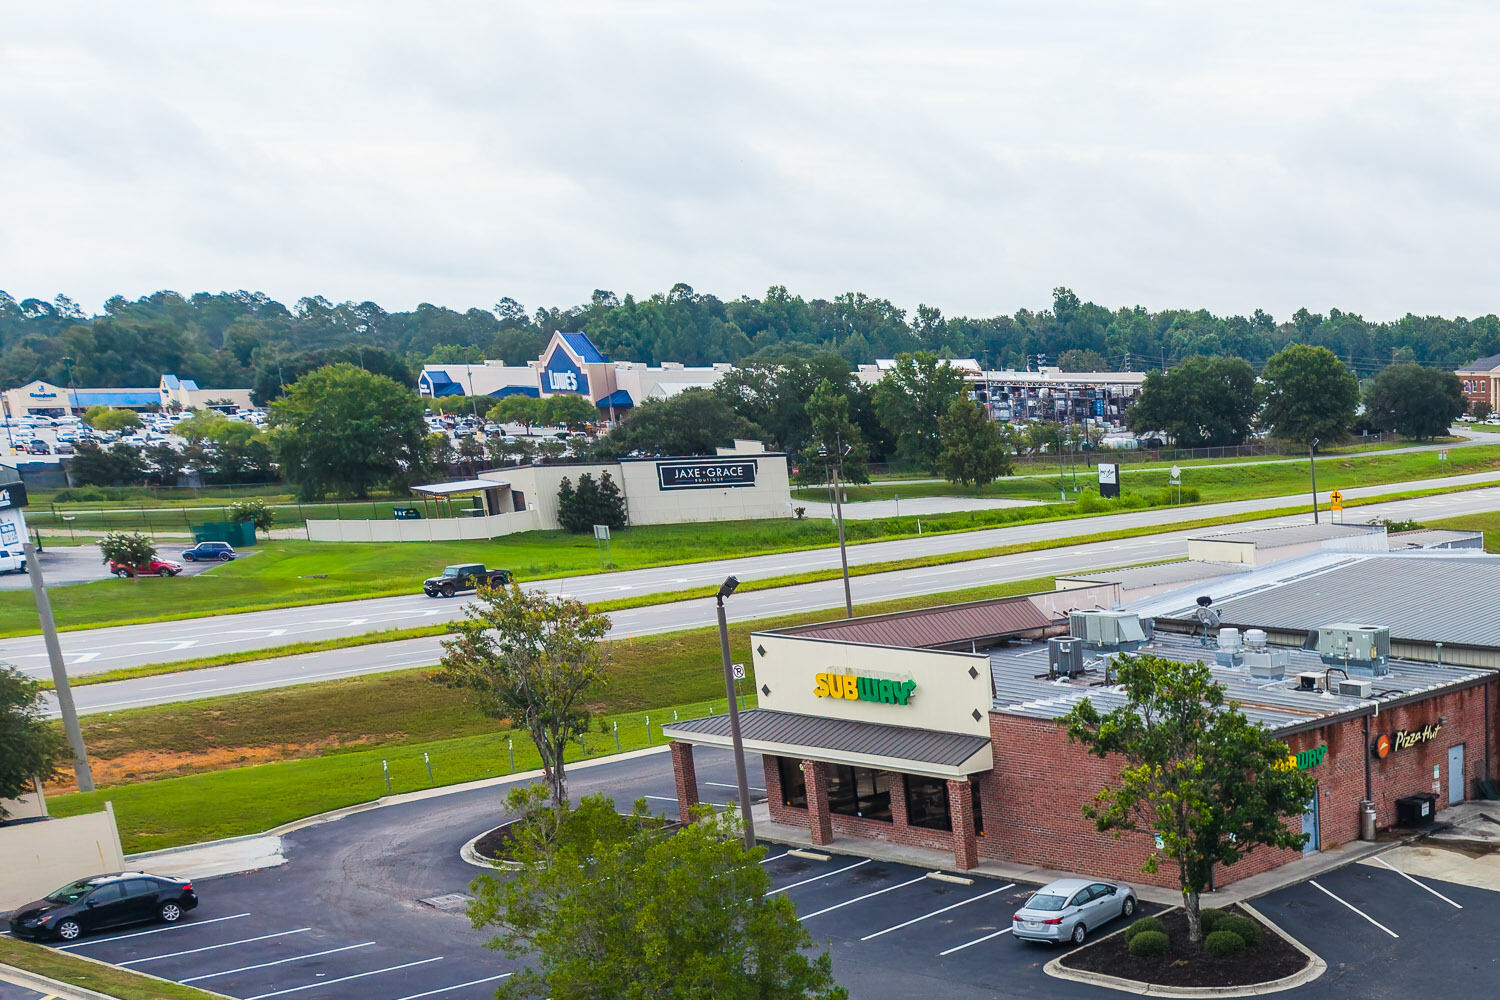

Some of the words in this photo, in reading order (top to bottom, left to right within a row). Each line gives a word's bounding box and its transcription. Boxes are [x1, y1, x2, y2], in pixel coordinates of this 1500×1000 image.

[548, 369, 578, 391] LOWE'S
[674, 468, 700, 479] JAXE
[706, 467, 743, 477] GRACE
[813, 672, 917, 706] SUBWAY
[1394, 731, 1421, 752] Pizza
[1421, 723, 1442, 743] Hut
